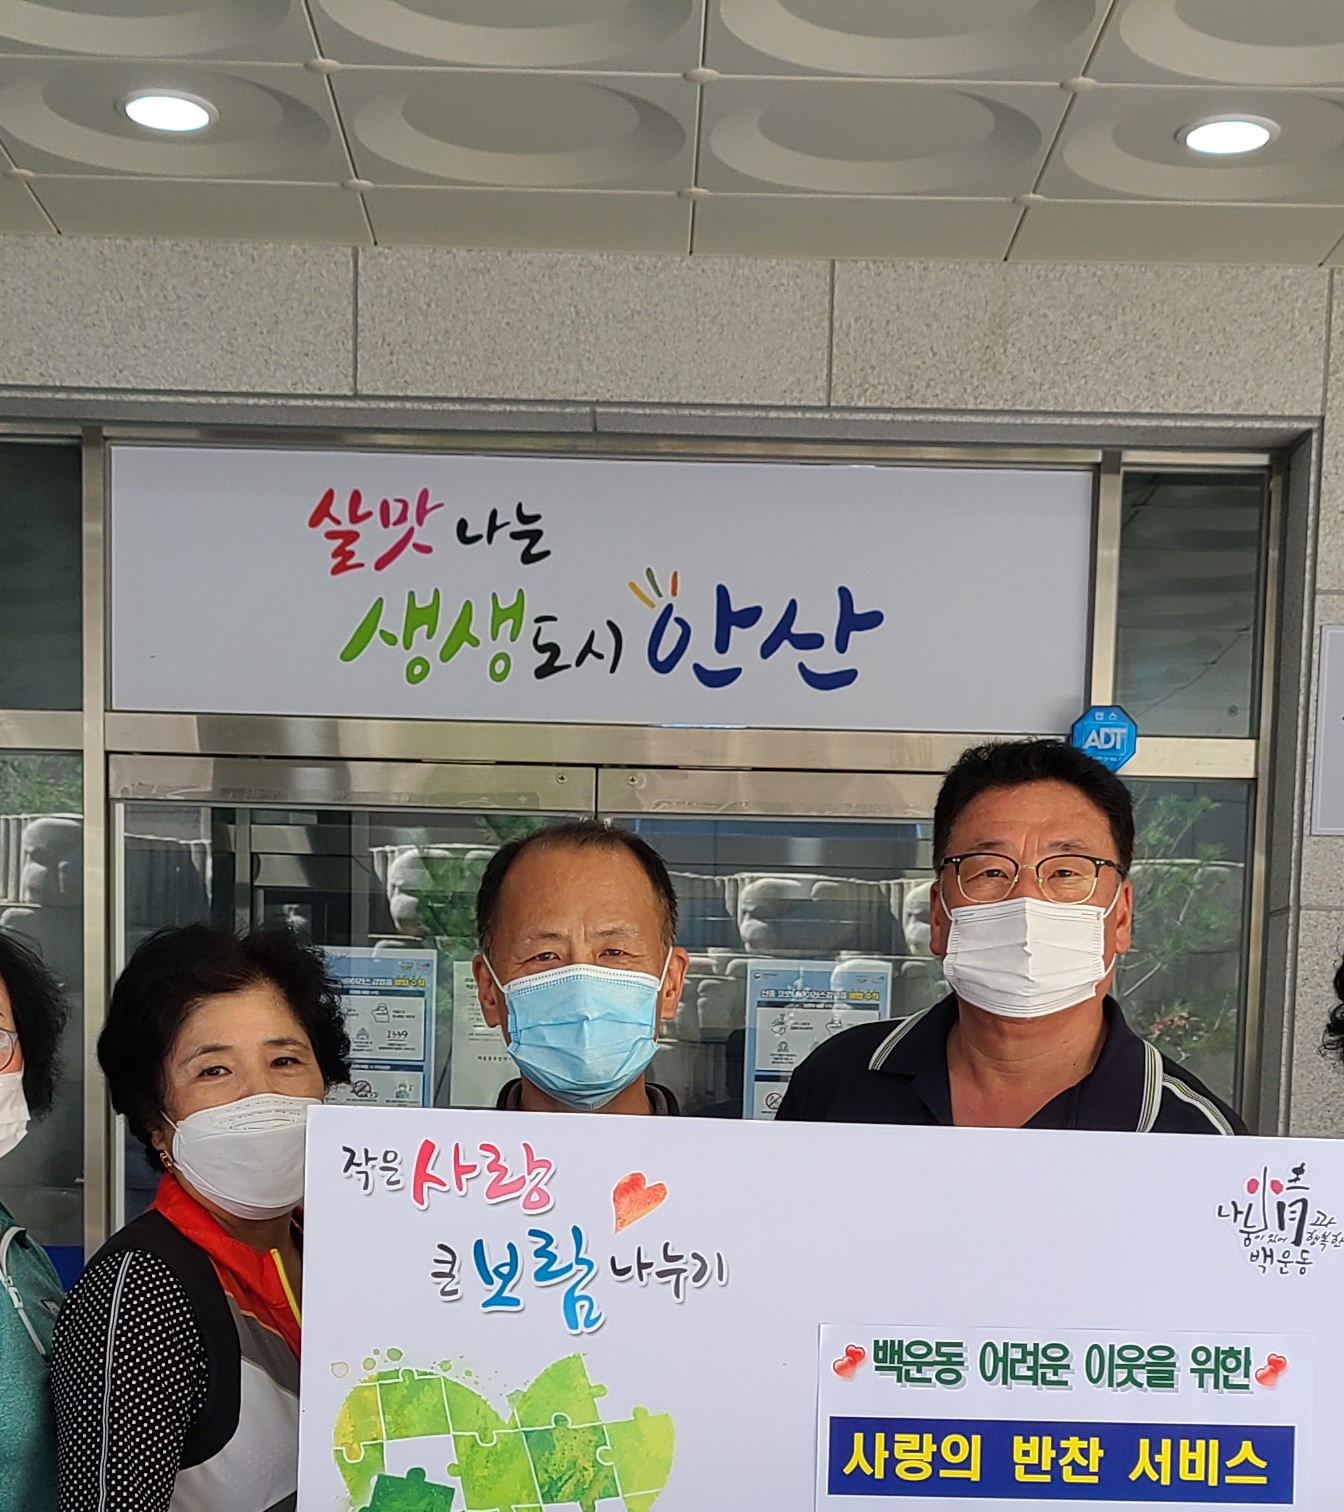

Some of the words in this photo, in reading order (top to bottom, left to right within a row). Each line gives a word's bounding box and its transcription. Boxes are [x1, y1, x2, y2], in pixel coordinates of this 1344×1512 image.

[648, 583, 884, 690] 안산
[1082, 728, 1127, 750] ADT
[342, 1145, 402, 1191] 작은
[412, 1139, 554, 1211] 사랑
[430, 1243, 459, 1297] 큰
[473, 1225, 603, 1331] 보람
[610, 1242, 727, 1300] 나누기
[1249, 1246, 1313, 1275] 백운동
[872, 1338, 964, 1385] 백운동
[978, 1341, 1071, 1387] 어려운
[1085, 1343, 1175, 1389] 이웃을
[1189, 1345, 1252, 1391] 위한
[842, 1432, 981, 1482] 사랑의
[1013, 1435, 1104, 1484] 반찬
[1128, 1438, 1268, 1487] 서비스
